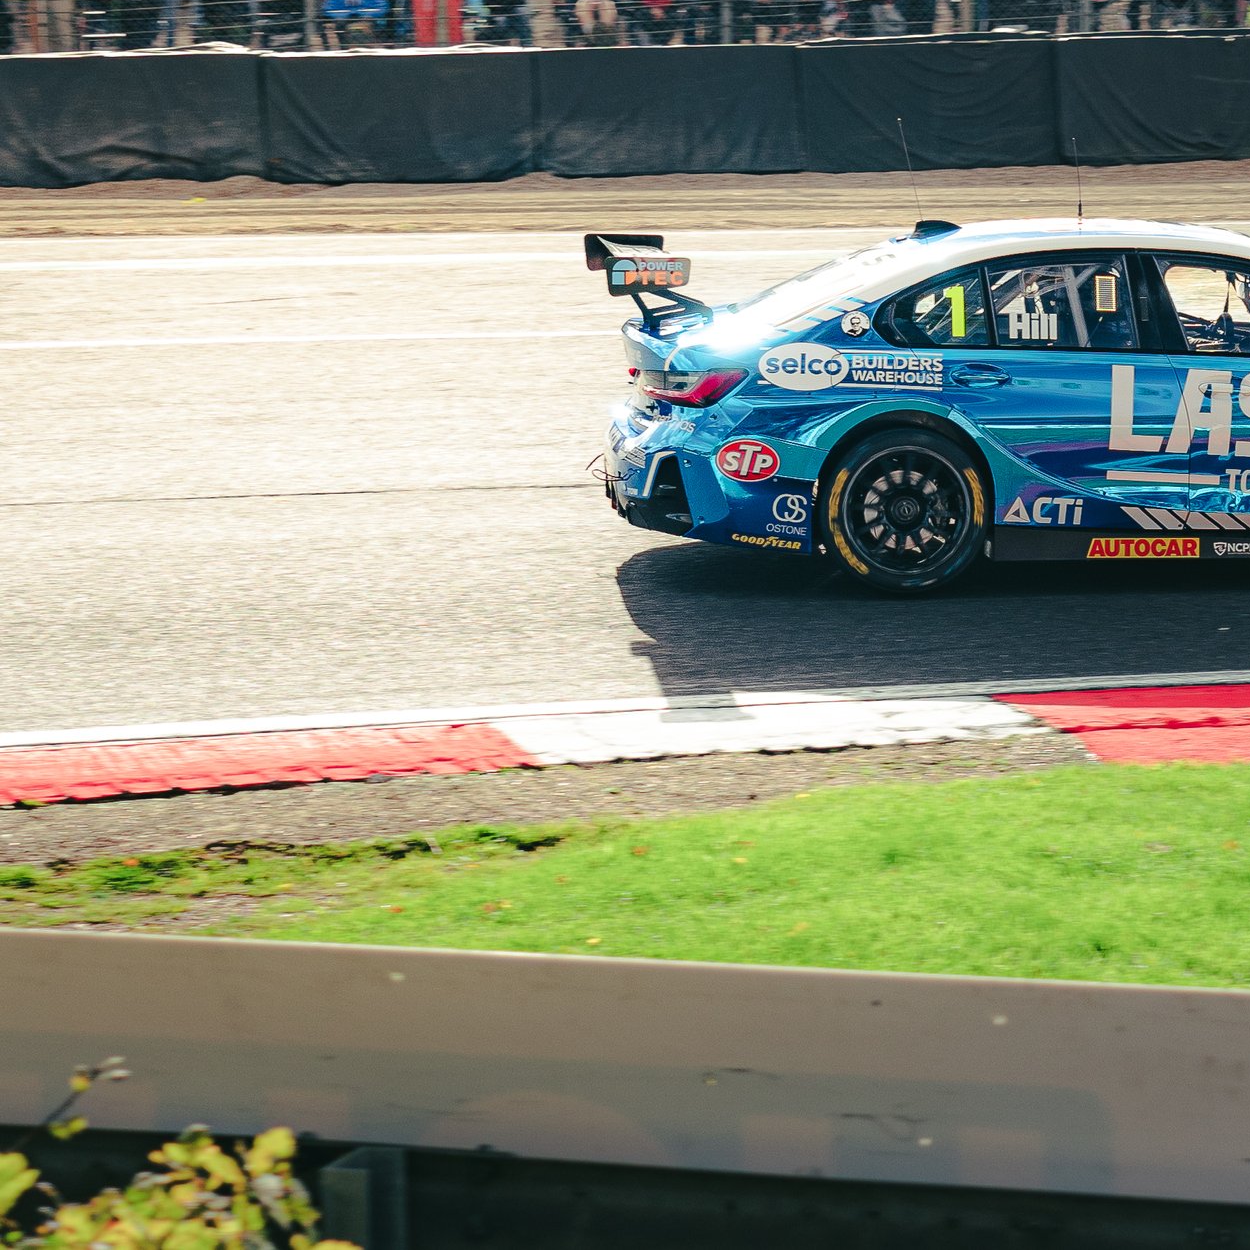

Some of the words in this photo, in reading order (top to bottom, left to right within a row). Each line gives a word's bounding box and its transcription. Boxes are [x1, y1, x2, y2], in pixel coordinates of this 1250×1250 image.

[639, 261, 684, 271] POWER
[641, 271, 684, 285] TEC
[943, 285, 966, 338] 1
[1009, 313, 1058, 340] Hill
[765, 353, 843, 376] selco
[852, 355, 944, 372] BUILDERS
[852, 370, 943, 385] WAREHOUSE
[723, 444, 774, 477] STP
[766, 523, 808, 536] OSTONE
[731, 533, 802, 550] GOODYEAR
[1088, 538, 1198, 558] AUTOCAR
